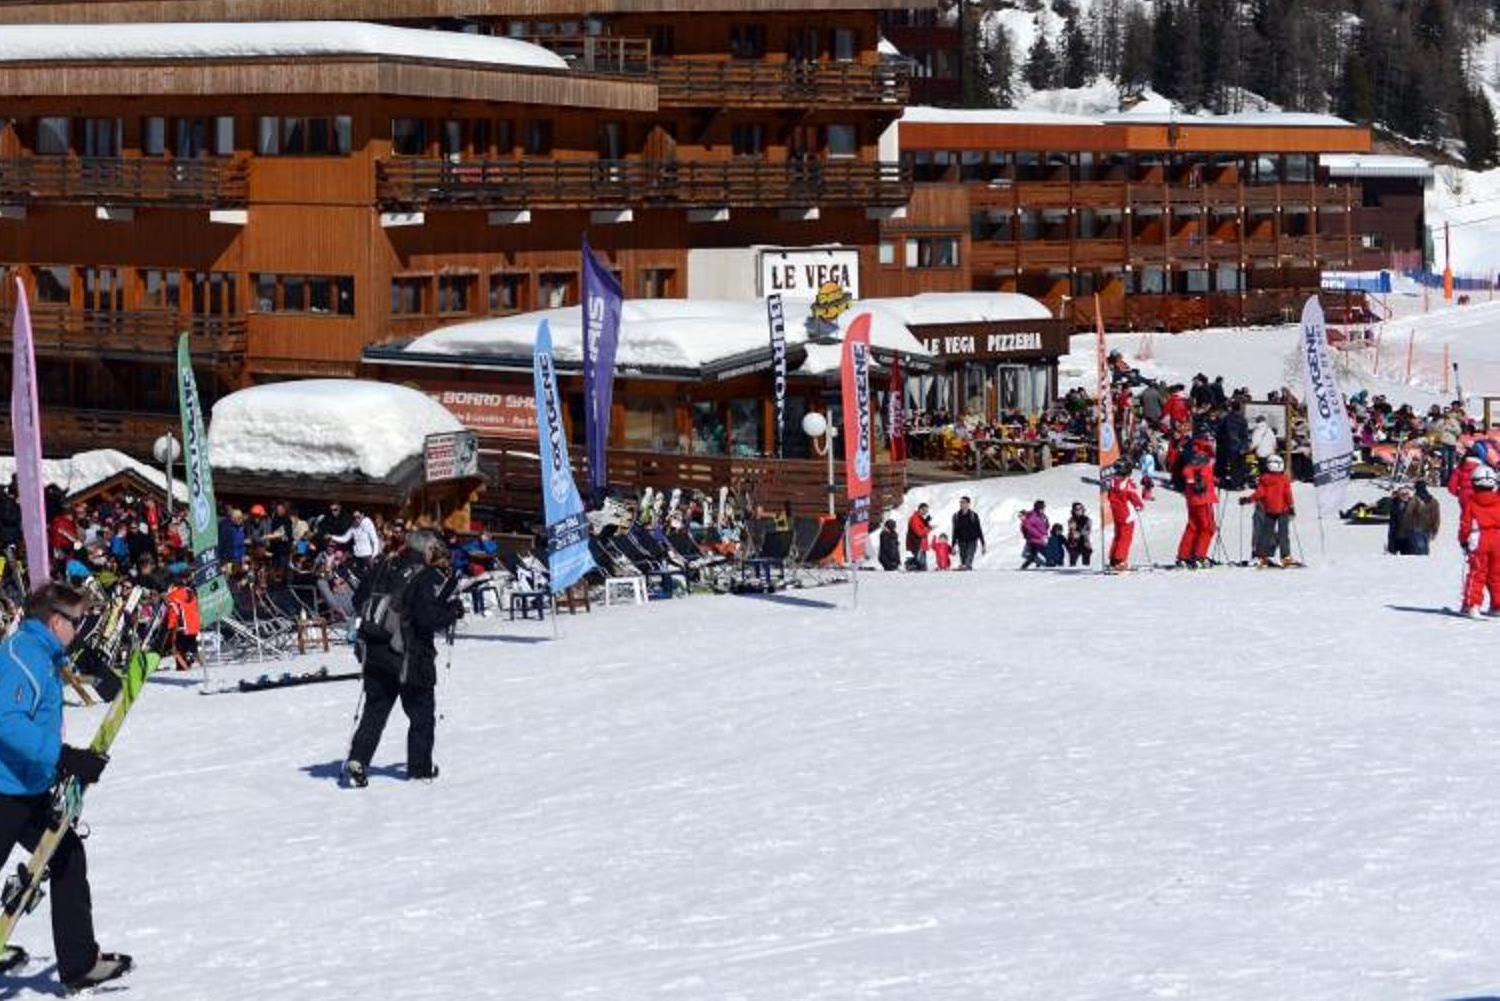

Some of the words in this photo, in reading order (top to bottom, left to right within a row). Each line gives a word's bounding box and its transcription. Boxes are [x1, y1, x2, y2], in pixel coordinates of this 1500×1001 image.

[772, 265, 797, 290] LE
[805, 264, 851, 289] VEGA
[923, 338, 940, 356] LE
[944, 335, 976, 354] VEGA
[987, 332, 1043, 352] PIZZERIA
[1305, 325, 1331, 421] OXYGENE
[443, 390, 502, 407] BOARD
[505, 394, 536, 408] SHO
[539, 354, 562, 472] OXYGENE
[855, 343, 869, 452] OXYGENE
